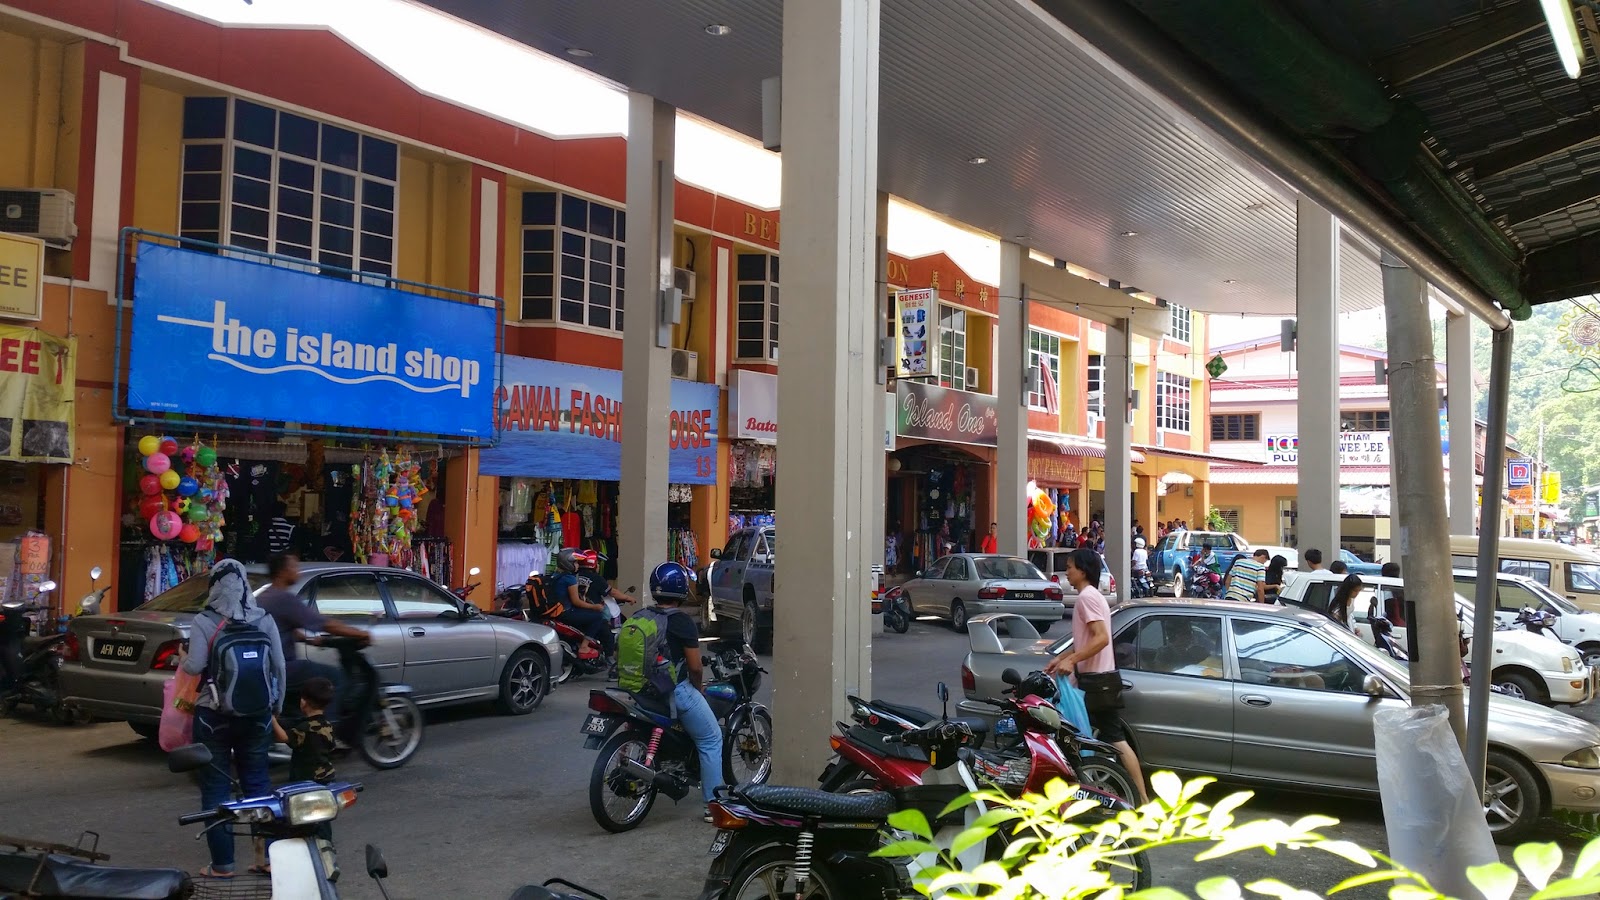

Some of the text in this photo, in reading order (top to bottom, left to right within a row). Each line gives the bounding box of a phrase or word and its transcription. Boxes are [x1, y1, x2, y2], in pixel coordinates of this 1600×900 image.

[898, 291, 931, 302] GENESIS
[165, 300, 481, 398] the island shop
[493, 384, 560, 432] CAWAI
[903, 392, 954, 432] Island
[957, 403, 985, 435] One
[745, 417, 777, 433] Bata
[695, 455, 712, 478] 13
[1273, 454, 1298, 462] PLU
[100, 644, 134, 657] AFN 6140
